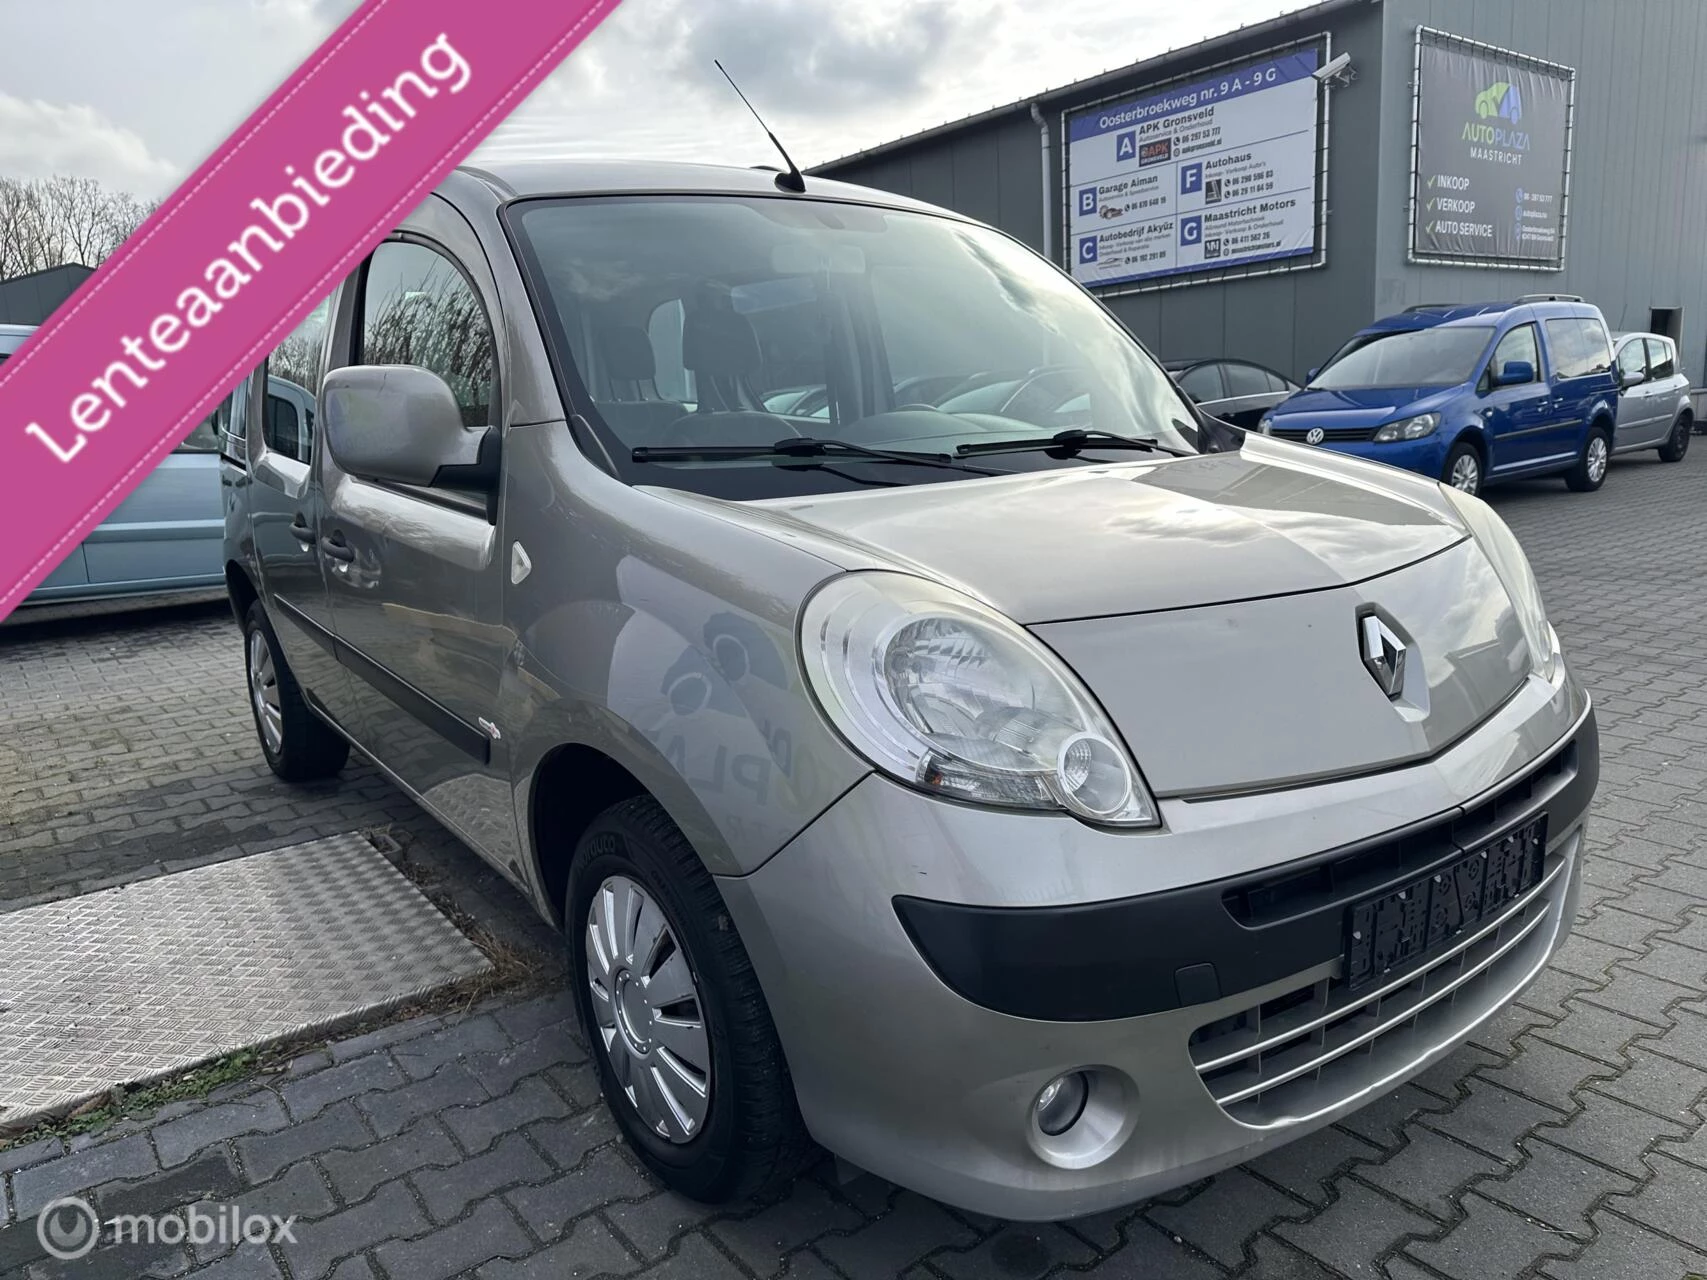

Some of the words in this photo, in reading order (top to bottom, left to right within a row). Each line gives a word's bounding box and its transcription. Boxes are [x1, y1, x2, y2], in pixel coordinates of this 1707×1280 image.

[1099, 93, 1197, 128] Oosterbroekweg
[1200, 88, 1217, 101] nr.
[1220, 82, 1229, 95] 9
[1231, 80, 1242, 92] A
[1253, 72, 1263, 86] 9
[1265, 68, 1276, 81] G
[1139, 123, 1160, 136] APK
[1162, 106, 1215, 128] Gronsveld
[1119, 136, 1133, 156] A
[1470, 146, 1522, 165] MAASTRICHT
[1205, 153, 1252, 170] Autohaus
[1099, 182, 1128, 195] Garage
[1131, 176, 1158, 188] Aiman
[1186, 168, 1197, 188] F
[1437, 174, 1470, 190] INKOOP
[1082, 193, 1094, 211] B
[1204, 206, 1257, 223] Maastricht
[1260, 199, 1296, 213] Motors
[1436, 197, 1475, 214] VERKOOP
[1099, 225, 1145, 243] Autobedrijf
[1183, 222, 1198, 241] G
[1435, 219, 1458, 234] AUTO
[1459, 222, 1493, 237] SERVICE
[1082, 242, 1094, 259] C
